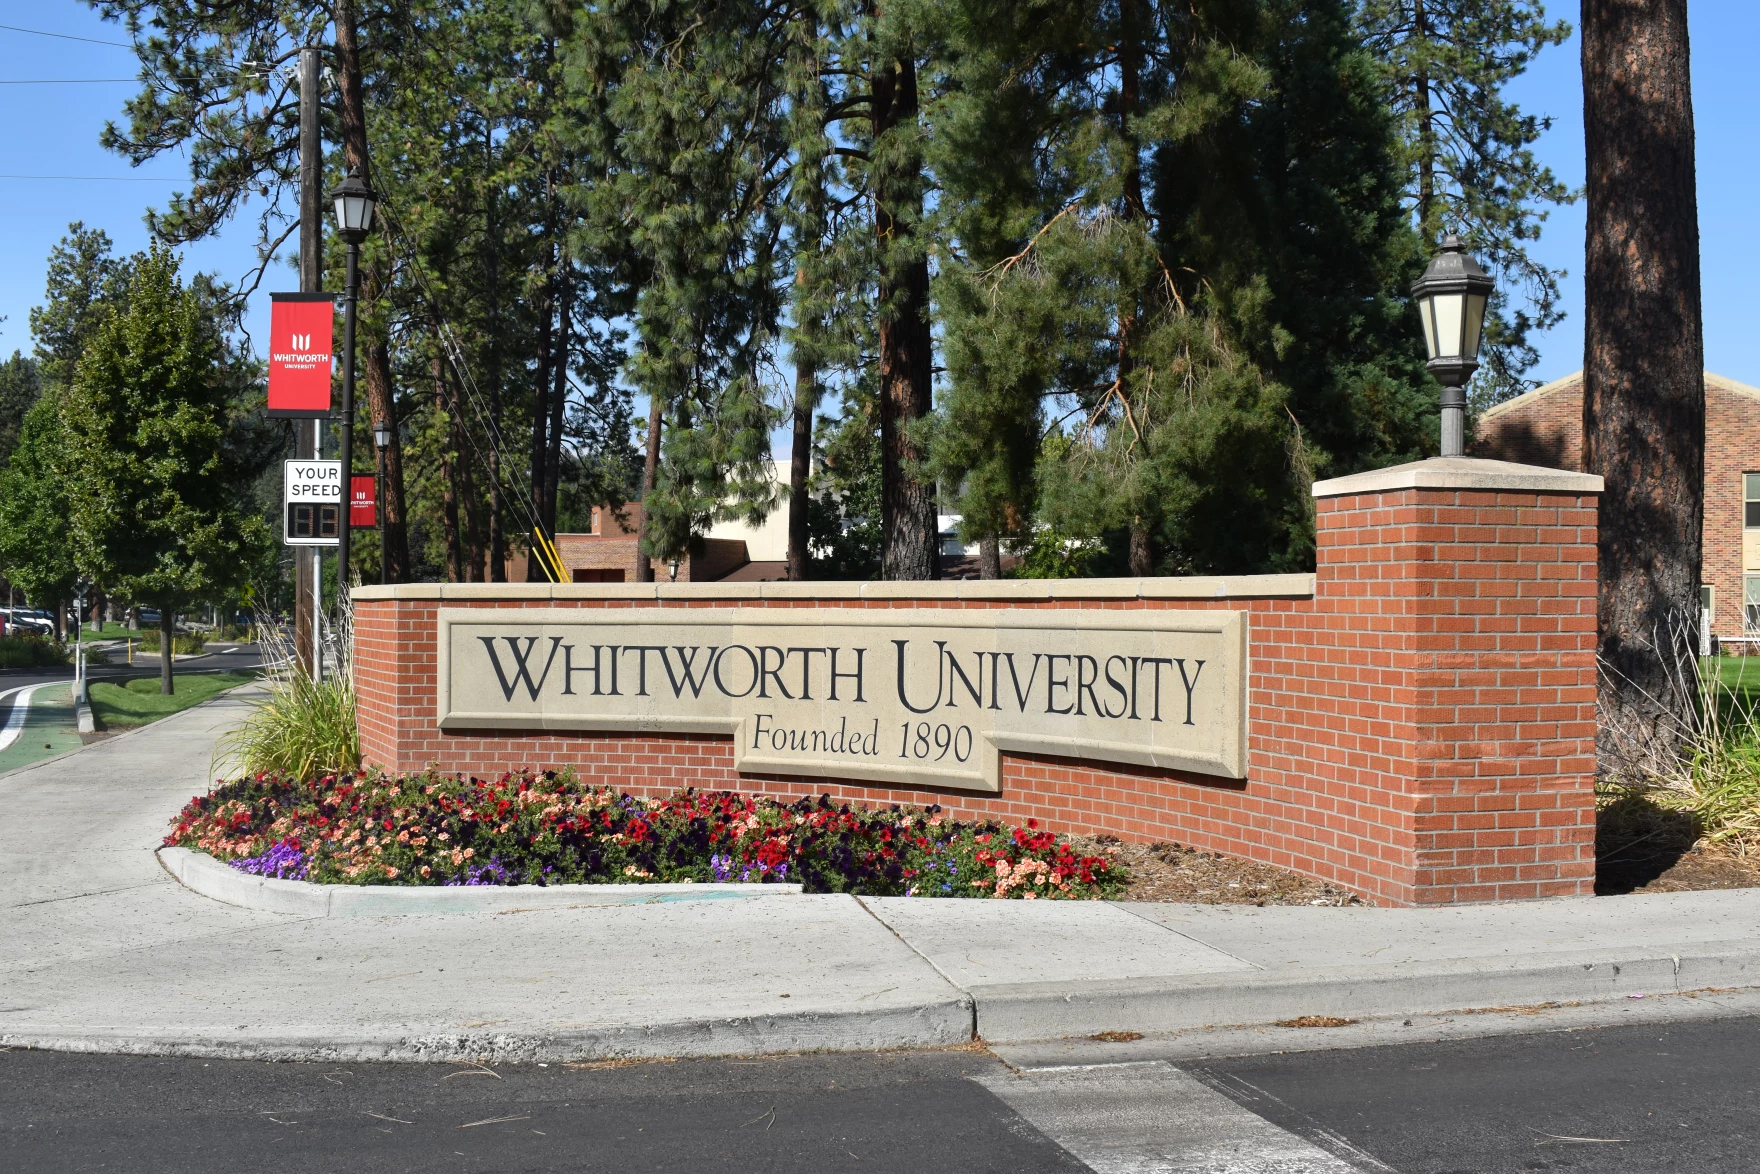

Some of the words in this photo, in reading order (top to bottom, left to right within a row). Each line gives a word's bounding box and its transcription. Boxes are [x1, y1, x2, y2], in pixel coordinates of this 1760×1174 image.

[273, 353, 329, 363] WHITWORTH
[295, 467, 338, 479] YOUR
[291, 484, 341, 496] SPEED
[476, 635, 868, 703] WHITWORTH
[890, 639, 1206, 726] UNIVERSITY
[751, 713, 880, 756] Founded
[898, 722, 973, 763] 1890
